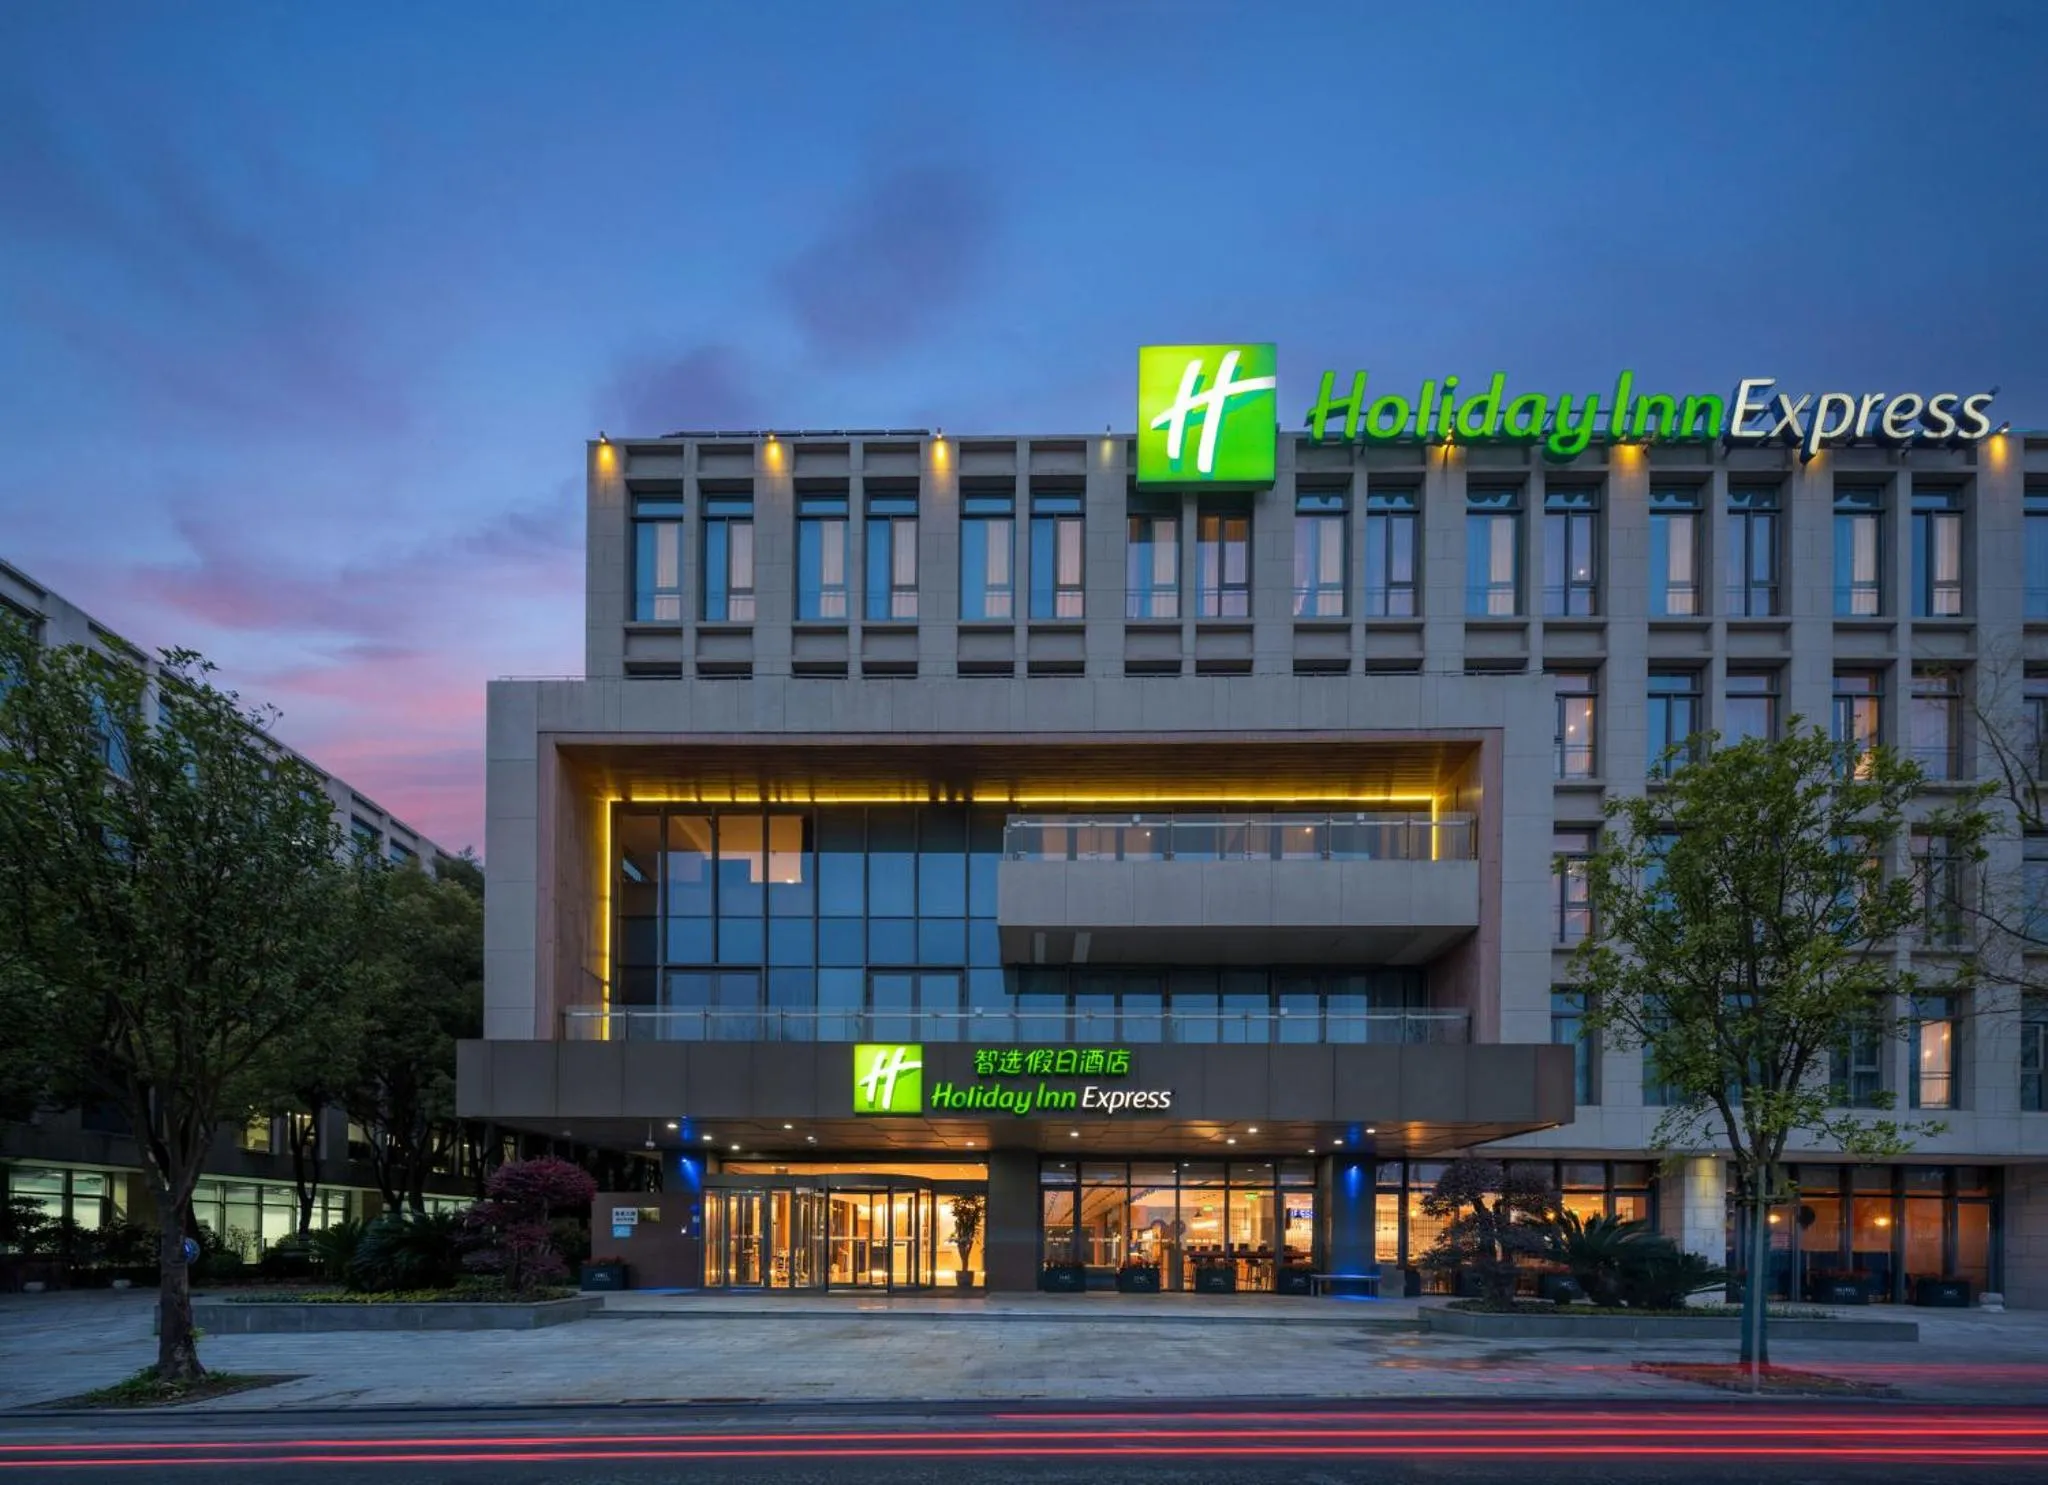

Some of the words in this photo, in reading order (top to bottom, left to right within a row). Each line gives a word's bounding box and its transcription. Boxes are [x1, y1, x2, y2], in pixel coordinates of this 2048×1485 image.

[1306, 370, 1600, 463] Holiday
[1608, 370, 1723, 441] Inn
[1729, 377, 1994, 457] Express
[974, 1049, 1130, 1075] 智选假日酒店
[931, 1082, 1033, 1114] Holiday
[1036, 1082, 1077, 1108] Inn
[1082, 1086, 1172, 1113] Express
